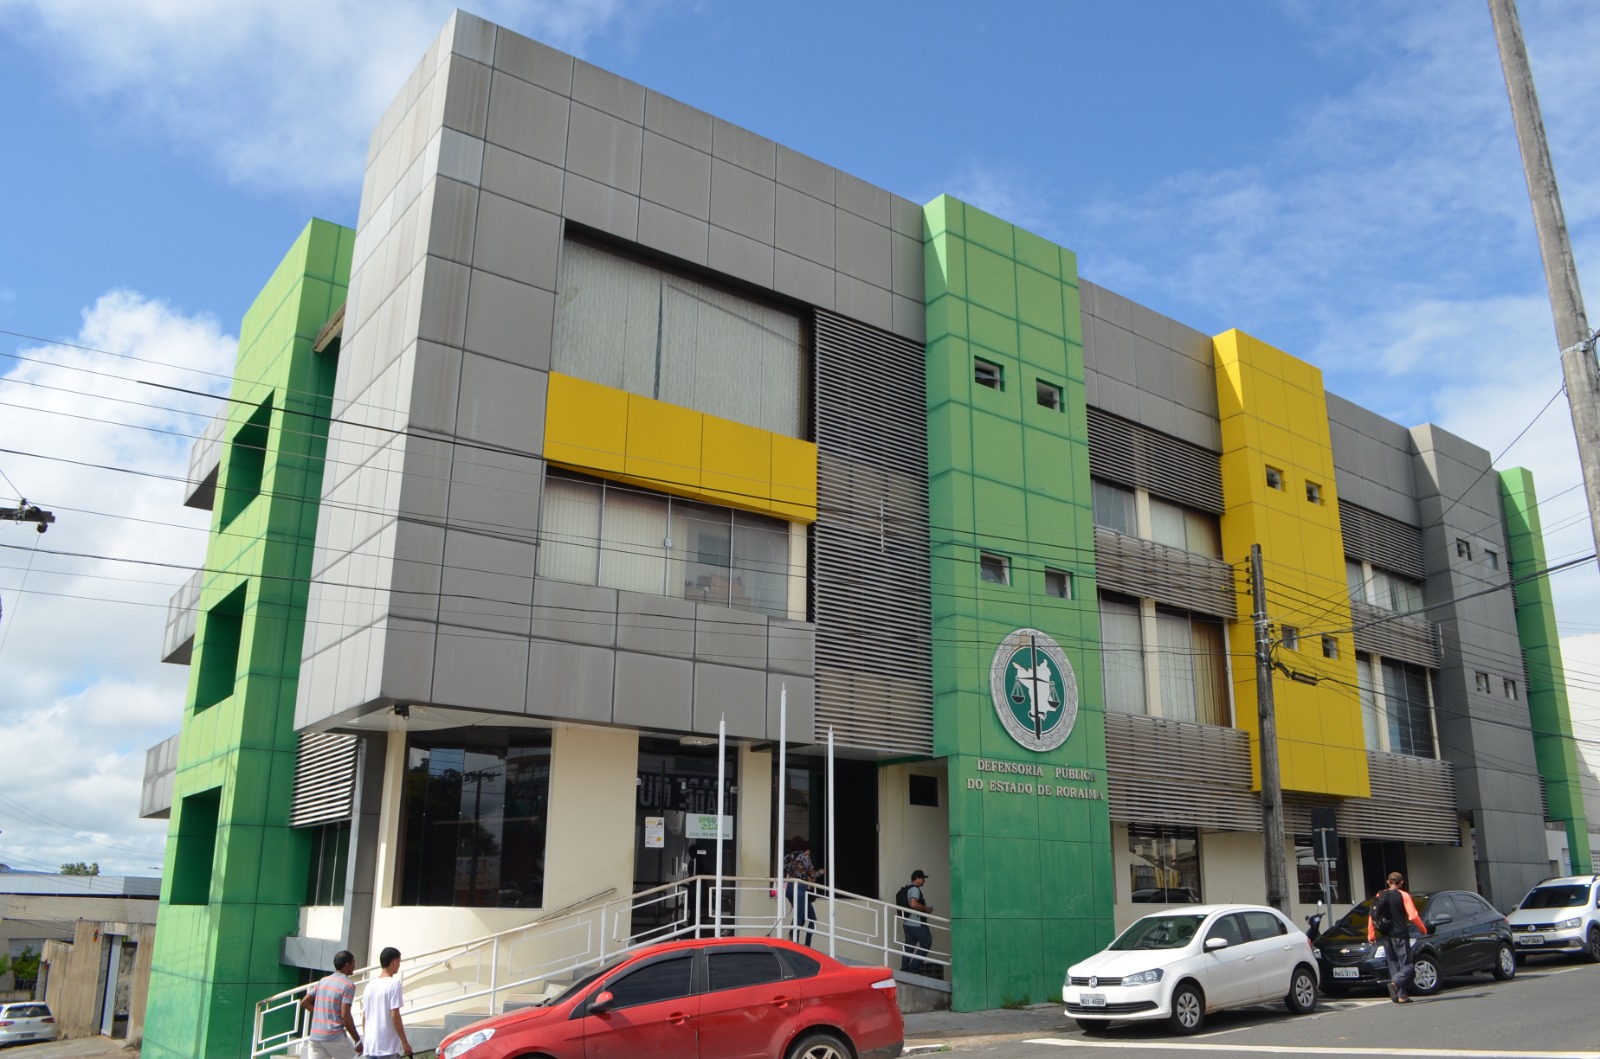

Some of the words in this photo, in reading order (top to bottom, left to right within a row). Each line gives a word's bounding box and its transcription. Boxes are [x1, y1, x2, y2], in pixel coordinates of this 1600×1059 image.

[977, 760, 1043, 776] DEFENSORIA
[1055, 763, 1095, 782] PÚBLICA
[967, 778, 983, 790] DO
[989, 780, 1032, 793] ESTADO
[1037, 785, 1051, 796] DE
[1056, 786, 1103, 800] RORAIMA
